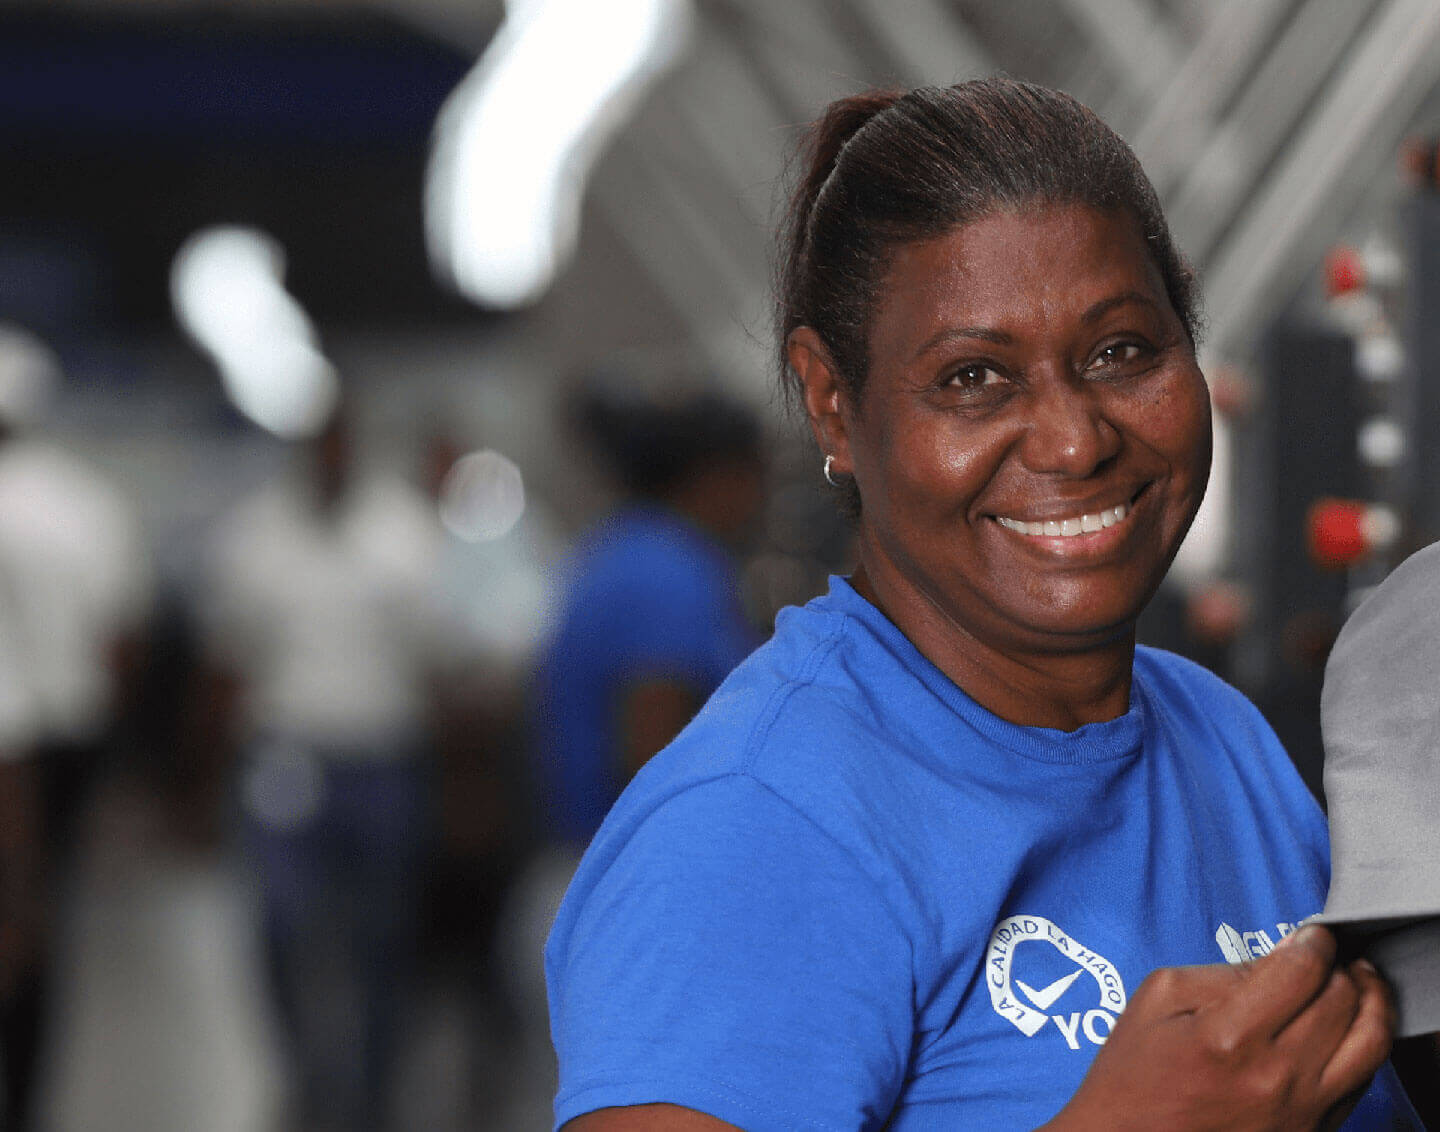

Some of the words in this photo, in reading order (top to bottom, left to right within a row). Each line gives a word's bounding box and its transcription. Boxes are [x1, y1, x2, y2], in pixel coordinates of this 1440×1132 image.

[991, 919, 1039, 989] CALIDAD
[1047, 924, 1070, 951] LA
[1076, 950, 1122, 1005] HAGO
[998, 996, 1026, 1021] LA
[1051, 1008, 1117, 1050] YO
